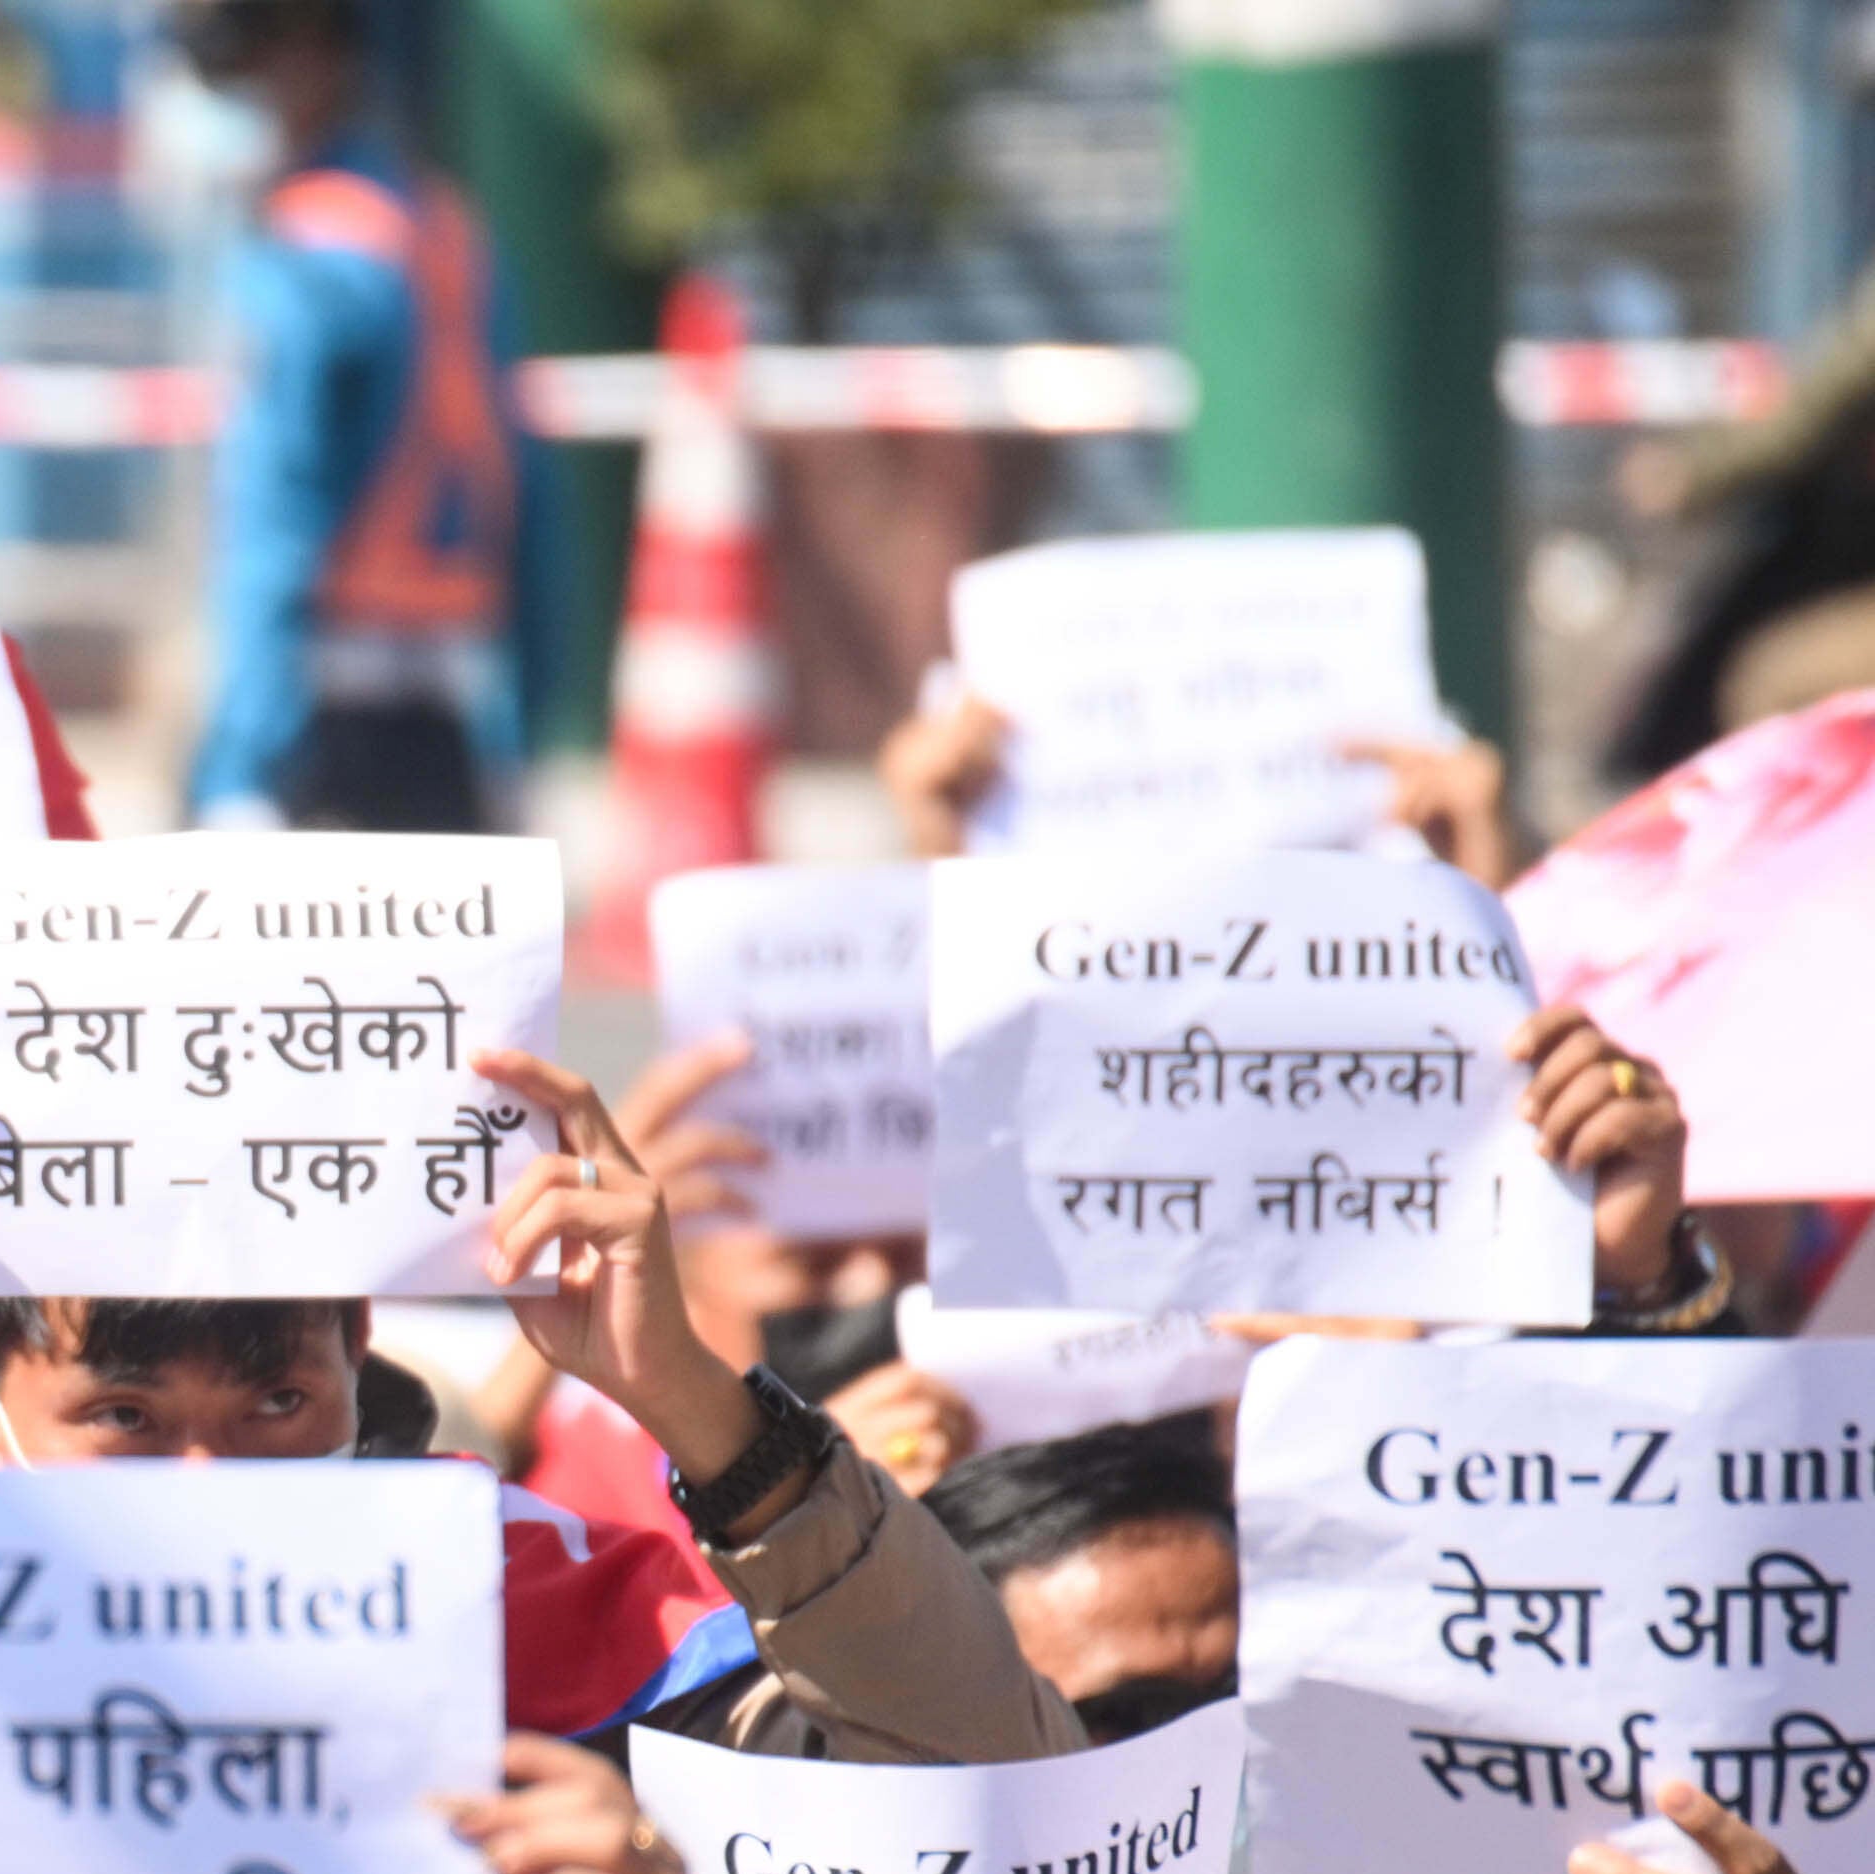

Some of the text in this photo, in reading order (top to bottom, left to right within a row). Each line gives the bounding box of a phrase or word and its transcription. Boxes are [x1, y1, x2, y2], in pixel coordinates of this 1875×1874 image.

[254, 884, 497, 939] united
[1035, 920, 1522, 985] Gen-Z united
[7, 976, 465, 1098] देश दुःखेको
[1099, 1028, 1475, 1108] शहीदहरुको
[242, 1138, 386, 1219] एक
[416, 1105, 526, 1215] हौँ
[1059, 1151, 1504, 1236] रगत नबिर्स !
[1365, 1423, 1875, 1506] Gen-Z uni
[90, 1555, 412, 1640] united
[1432, 1550, 1849, 1675] देश अघि
[1410, 1713, 1655, 1820] स्वार्थ
